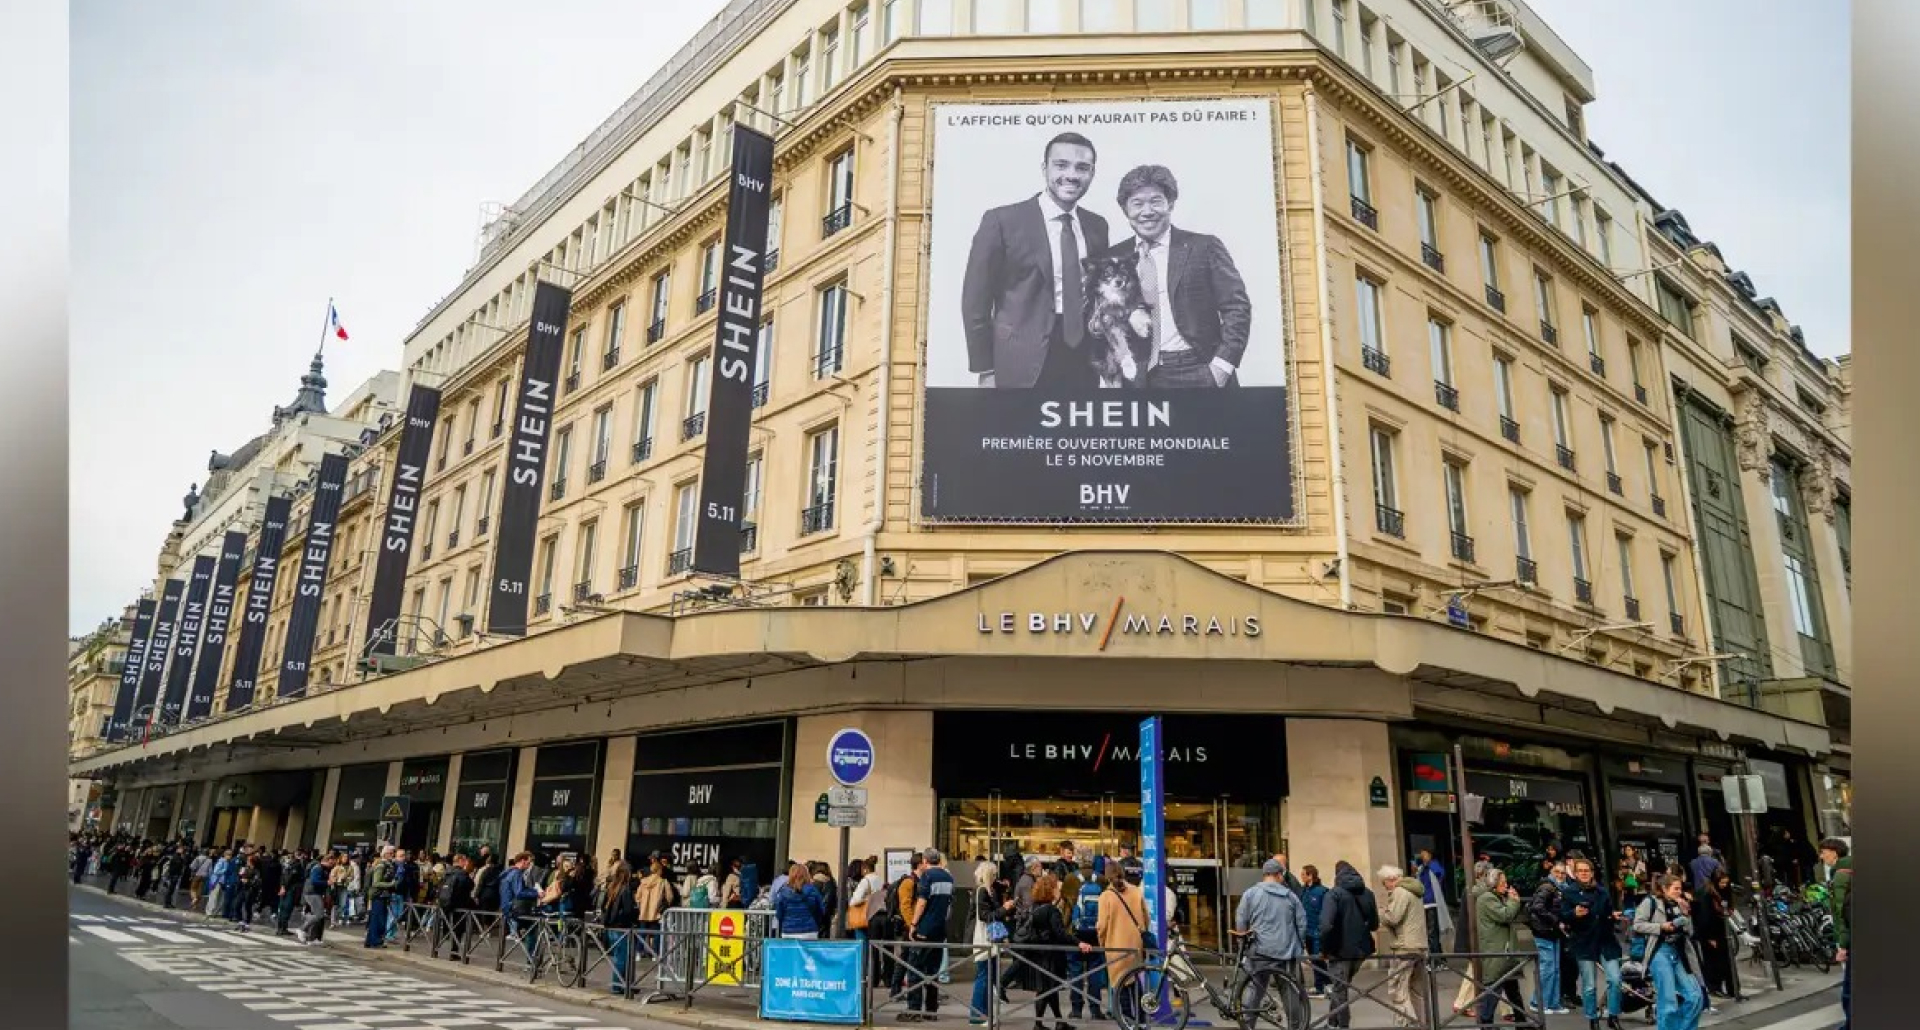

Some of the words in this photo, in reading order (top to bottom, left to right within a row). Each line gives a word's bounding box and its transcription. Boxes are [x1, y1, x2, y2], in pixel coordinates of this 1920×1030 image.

[948, 115, 1021, 126] L'AFFICHE
[1026, 114, 1073, 126] QU'ON
[1078, 112, 1146, 124] N'AURAIT
[1150, 112, 1178, 122] PAS
[1182, 109, 1203, 122] DÛ
[1207, 111, 1248, 121] FAIRE
[738, 173, 764, 193] BHV
[720, 244, 758, 383] SHEIN
[537, 322, 560, 336] BHV
[1040, 401, 1170, 428] SHEIN
[513, 378, 551, 487] SHEIN
[982, 435, 1053, 450] PREMIÈRE
[1057, 438, 1146, 450] OUVERTURE
[1151, 438, 1230, 450] MONDIALE
[1046, 454, 1063, 466] LE
[1068, 454, 1076, 466] 5
[1081, 454, 1165, 466] NOVEMBRE
[1080, 484, 1130, 504] BHV
[387, 463, 421, 552] SHEIN
[707, 502, 735, 522] 5.11
[301, 522, 332, 597] SHEIN
[248, 556, 276, 623] SHEIN
[499, 578, 523, 595] 5.11
[208, 585, 233, 644] SHEIN
[978, 613, 1015, 633] LE
[178, 601, 202, 658] SHEIN
[149, 621, 172, 672] SHEIN
[124, 638, 145, 685] SHEIN
[1010, 744, 1036, 758] LE
[689, 785, 714, 804] BHV
[672, 842, 720, 865] SHEIN
